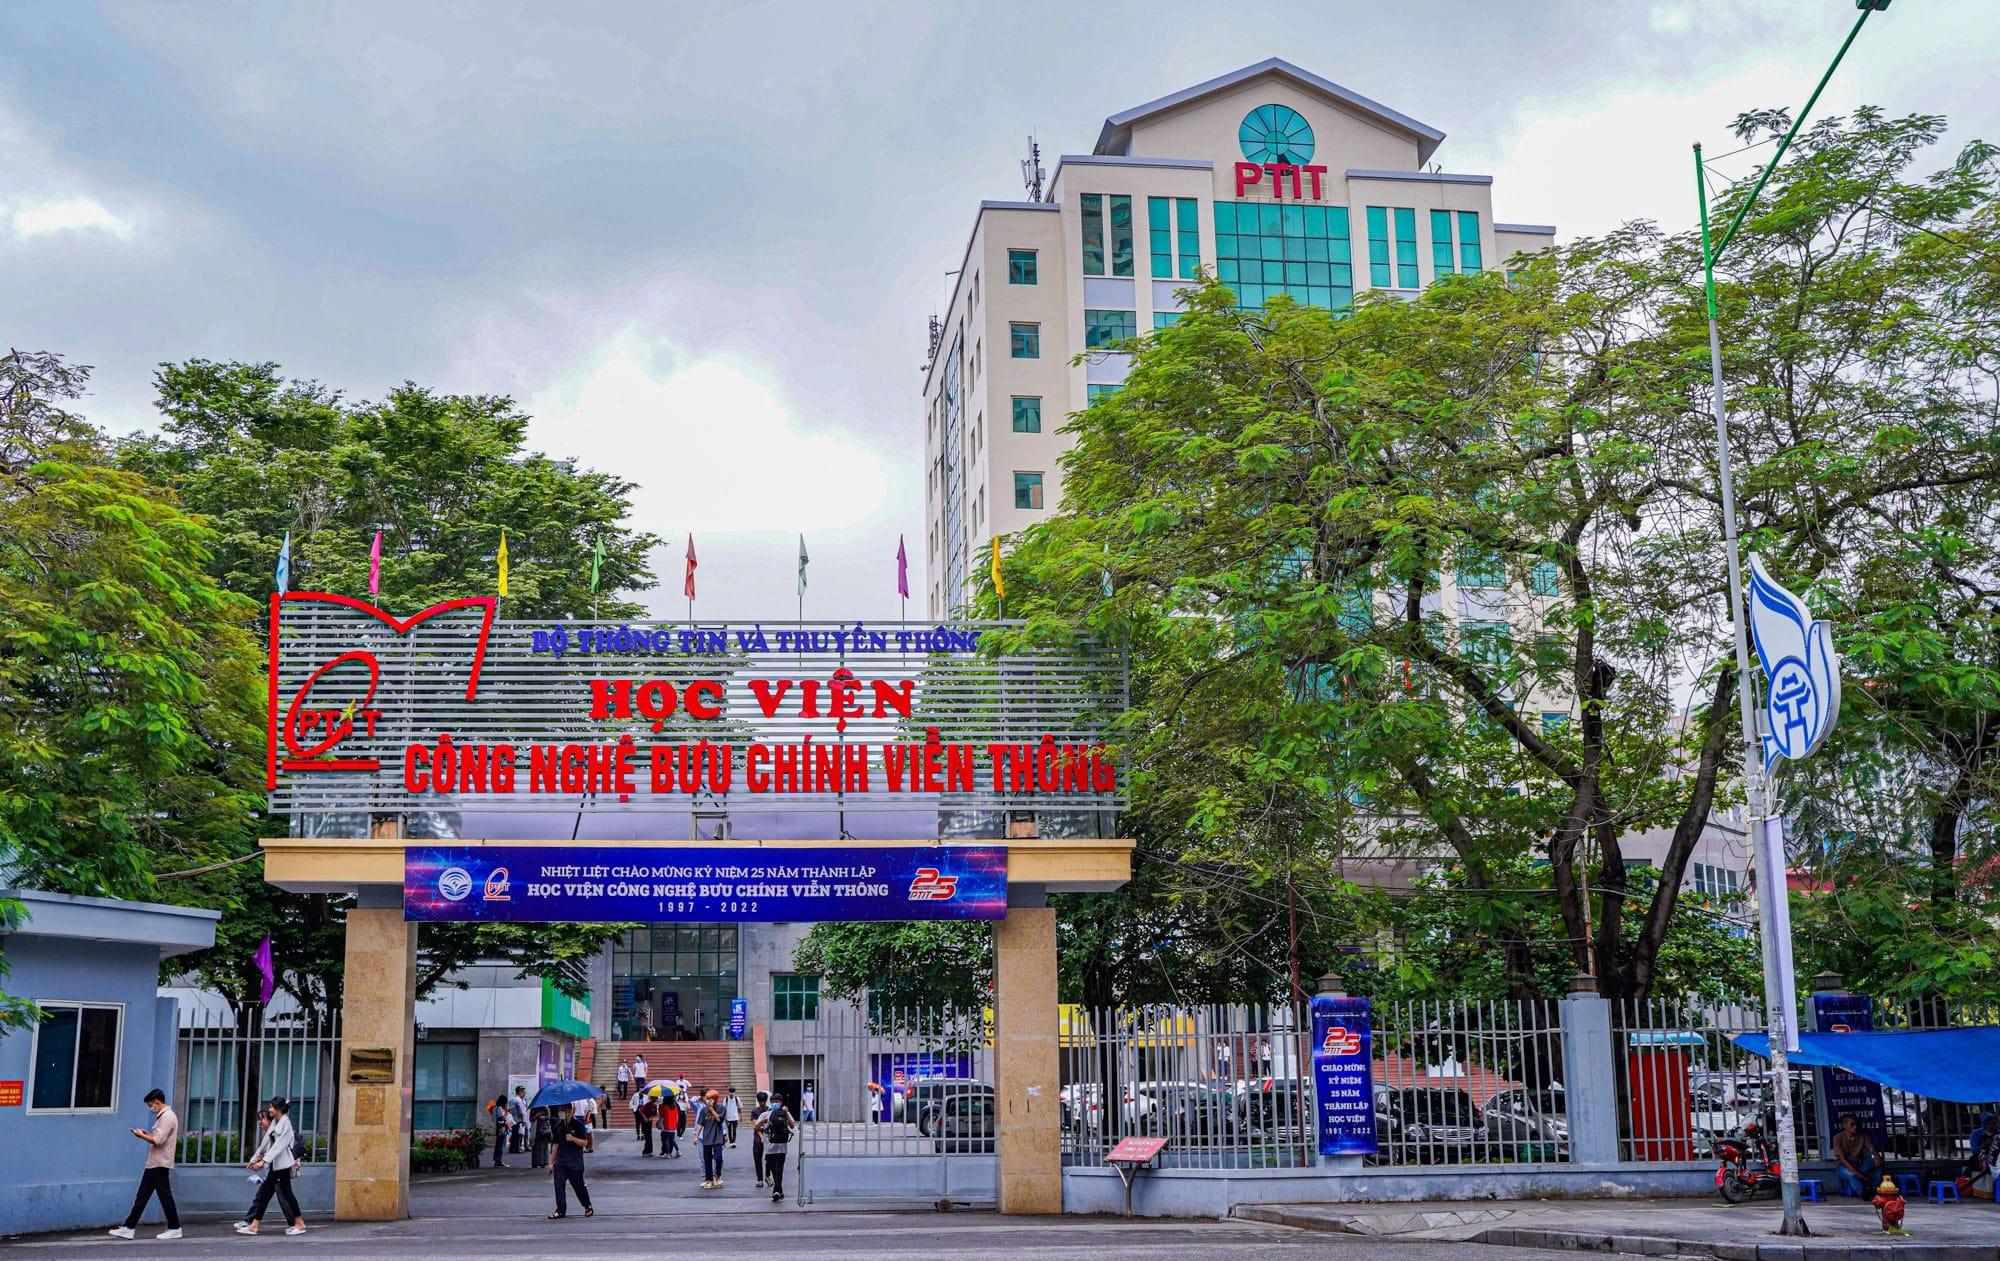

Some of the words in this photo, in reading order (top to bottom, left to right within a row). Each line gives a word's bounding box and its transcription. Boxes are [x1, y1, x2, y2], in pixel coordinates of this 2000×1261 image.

[1235, 162, 1328, 200] PTIT
[532, 624, 568, 658] BỘ
[577, 624, 671, 653] THÔNG
[677, 629, 727, 653] TIN
[736, 624, 770, 653] VÀ
[776, 620, 887, 653] TRUYỀN
[588, 680, 724, 733] HỌC
[747, 667, 915, 733] VIỆN
[404, 733, 516, 793] CÔNG
[529, 734, 638, 803] NGHỆ
[651, 739, 733, 793] BƯU
[746, 735, 869, 793] CHÍNH
[884, 727, 974, 793] VIỄN
[987, 733, 1116, 793] THÔNG
[541, 865, 579, 878] NHIỆT
[583, 865, 609, 878] LIỆT
[611, 866, 650, 878] CHÀO
[652, 866, 692, 878] MỪNG
[695, 865, 713, 878] KỶ
[715, 867, 748, 879] NIỆM
[751, 868, 765, 878] 25
[767, 867, 799, 878] NĂM
[801, 866, 849, 878] THÀNH
[851, 866, 876, 880] LẬP
[527, 884, 560, 899] HỌC
[565, 882, 603, 899] VIỆN
[607, 882, 649, 896] CÔNG
[652, 882, 696, 900] NGHỆ
[699, 883, 733, 897] BƯU
[736, 881, 789, 897] CHÍNH
[792, 879, 831, 897] VIỄN
[834, 882, 889, 897] THÔNG
[910, 868, 958, 900] 25
[658, 901, 694, 913] 1997
[720, 901, 758, 913] 2022
[1325, 1027, 1361, 1055] 25
[1321, 1064, 1343, 1072] CHÀO
[1341, 1076, 1362, 1086] NIỆM
[1341, 1089, 1360, 1097] NĂM
[1324, 1102, 1352, 1110] THÀNH
[1353, 1101, 1369, 1111] LẬP
[1328, 1115, 1345, 1124] HỌC
[1346, 1114, 1366, 1123] VIỆN
